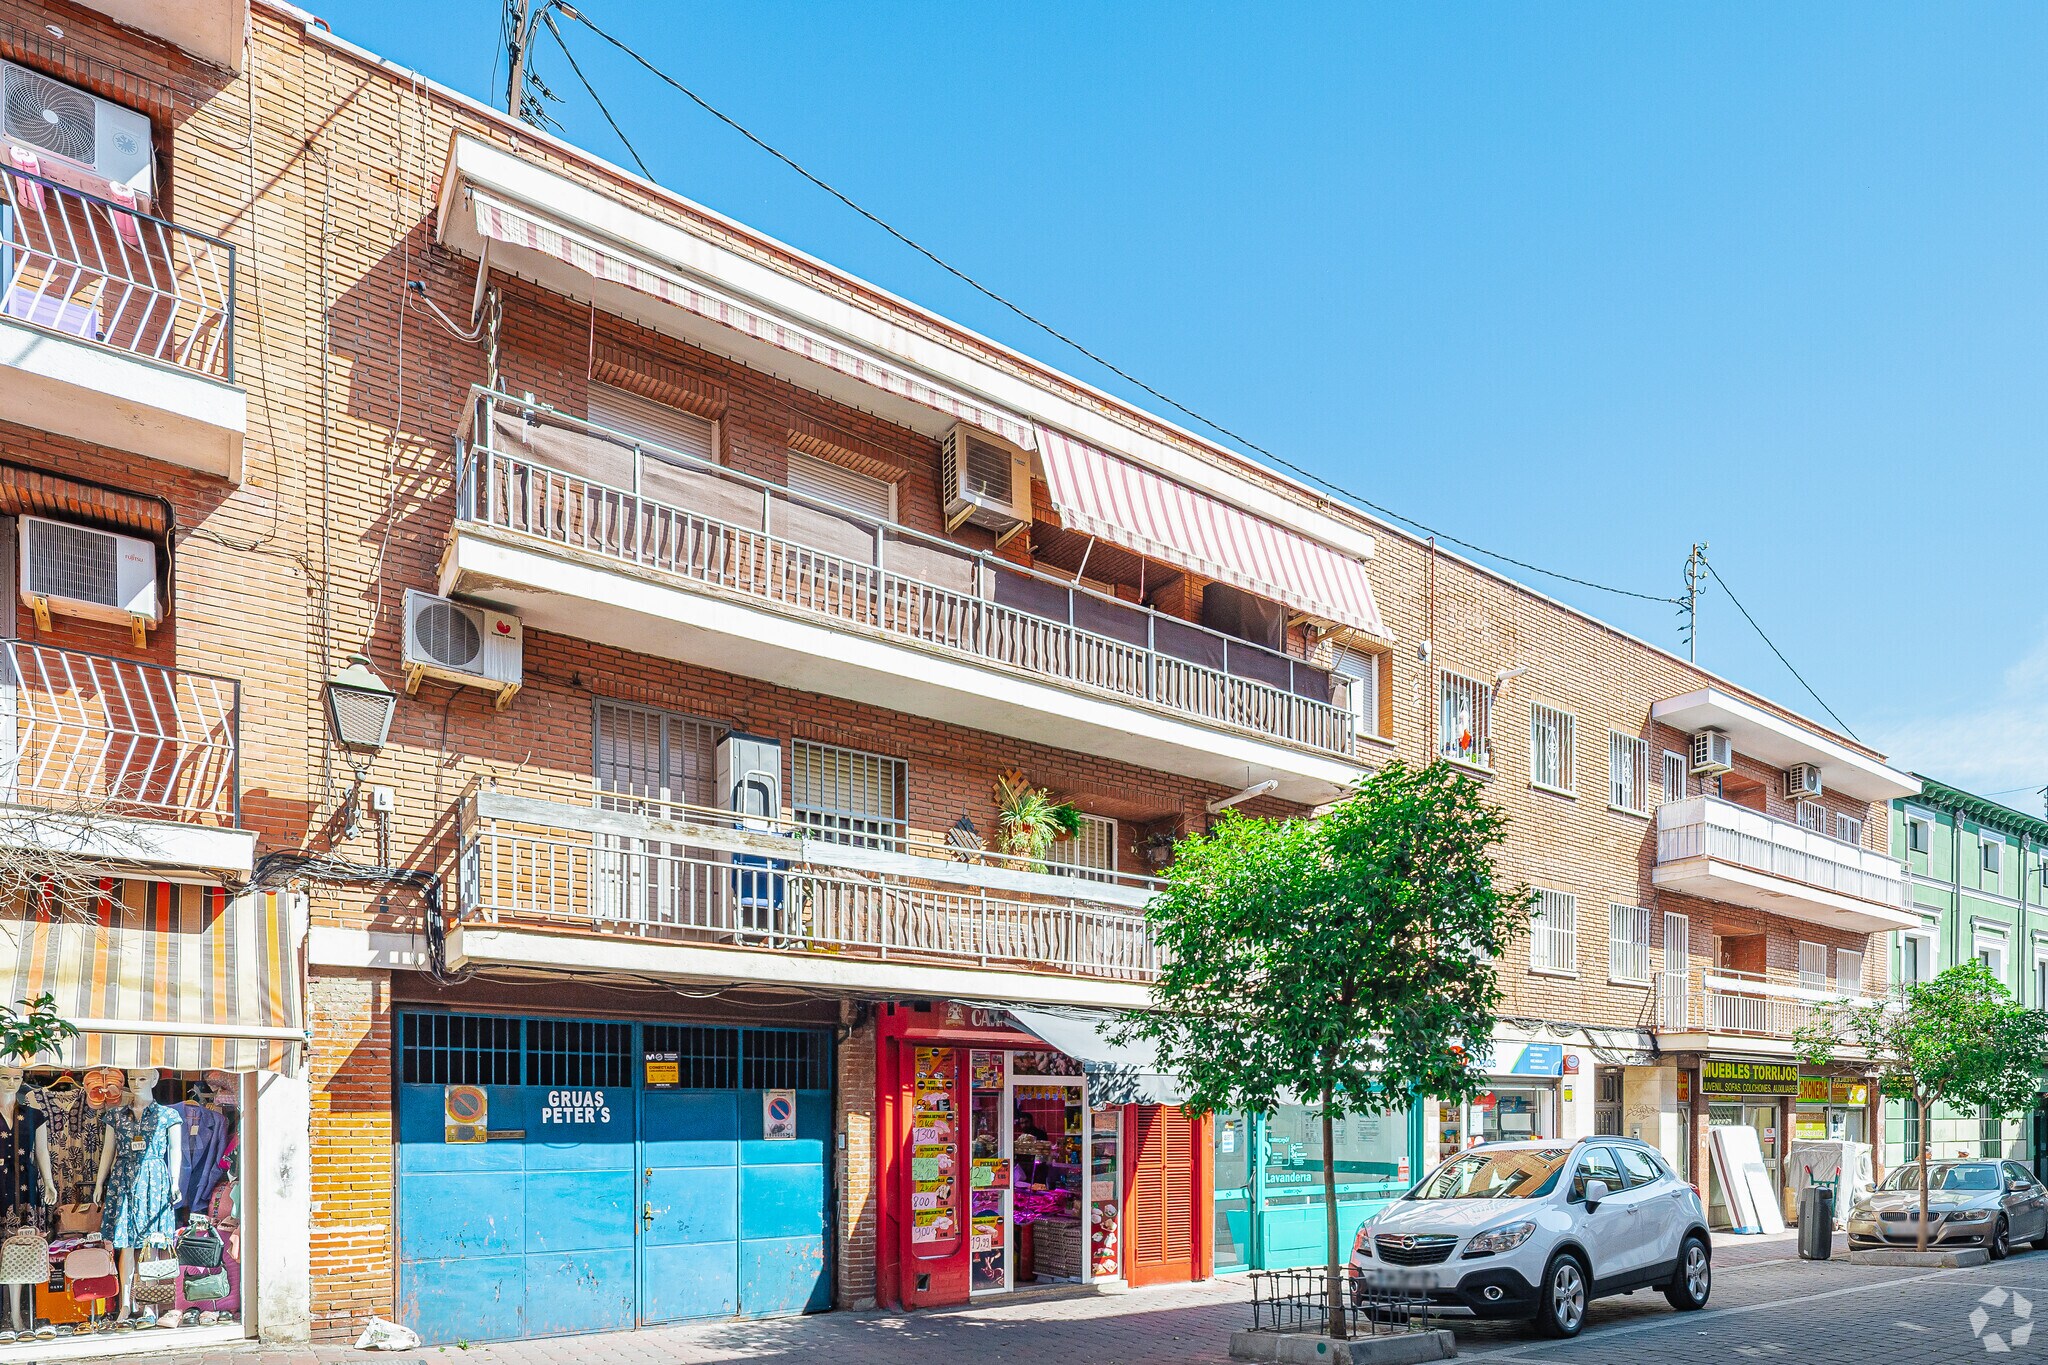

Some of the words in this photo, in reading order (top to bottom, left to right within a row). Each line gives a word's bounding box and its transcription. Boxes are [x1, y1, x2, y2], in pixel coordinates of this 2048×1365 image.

[1702, 1061, 1750, 1080] MUEBLES
[1752, 1064, 1798, 1081] TORRIJOS
[1773, 1084, 1798, 1094] AUXILIARES
[1797, 1080, 1828, 1099] CHONERIA
[548, 1090, 604, 1108] GRUAS
